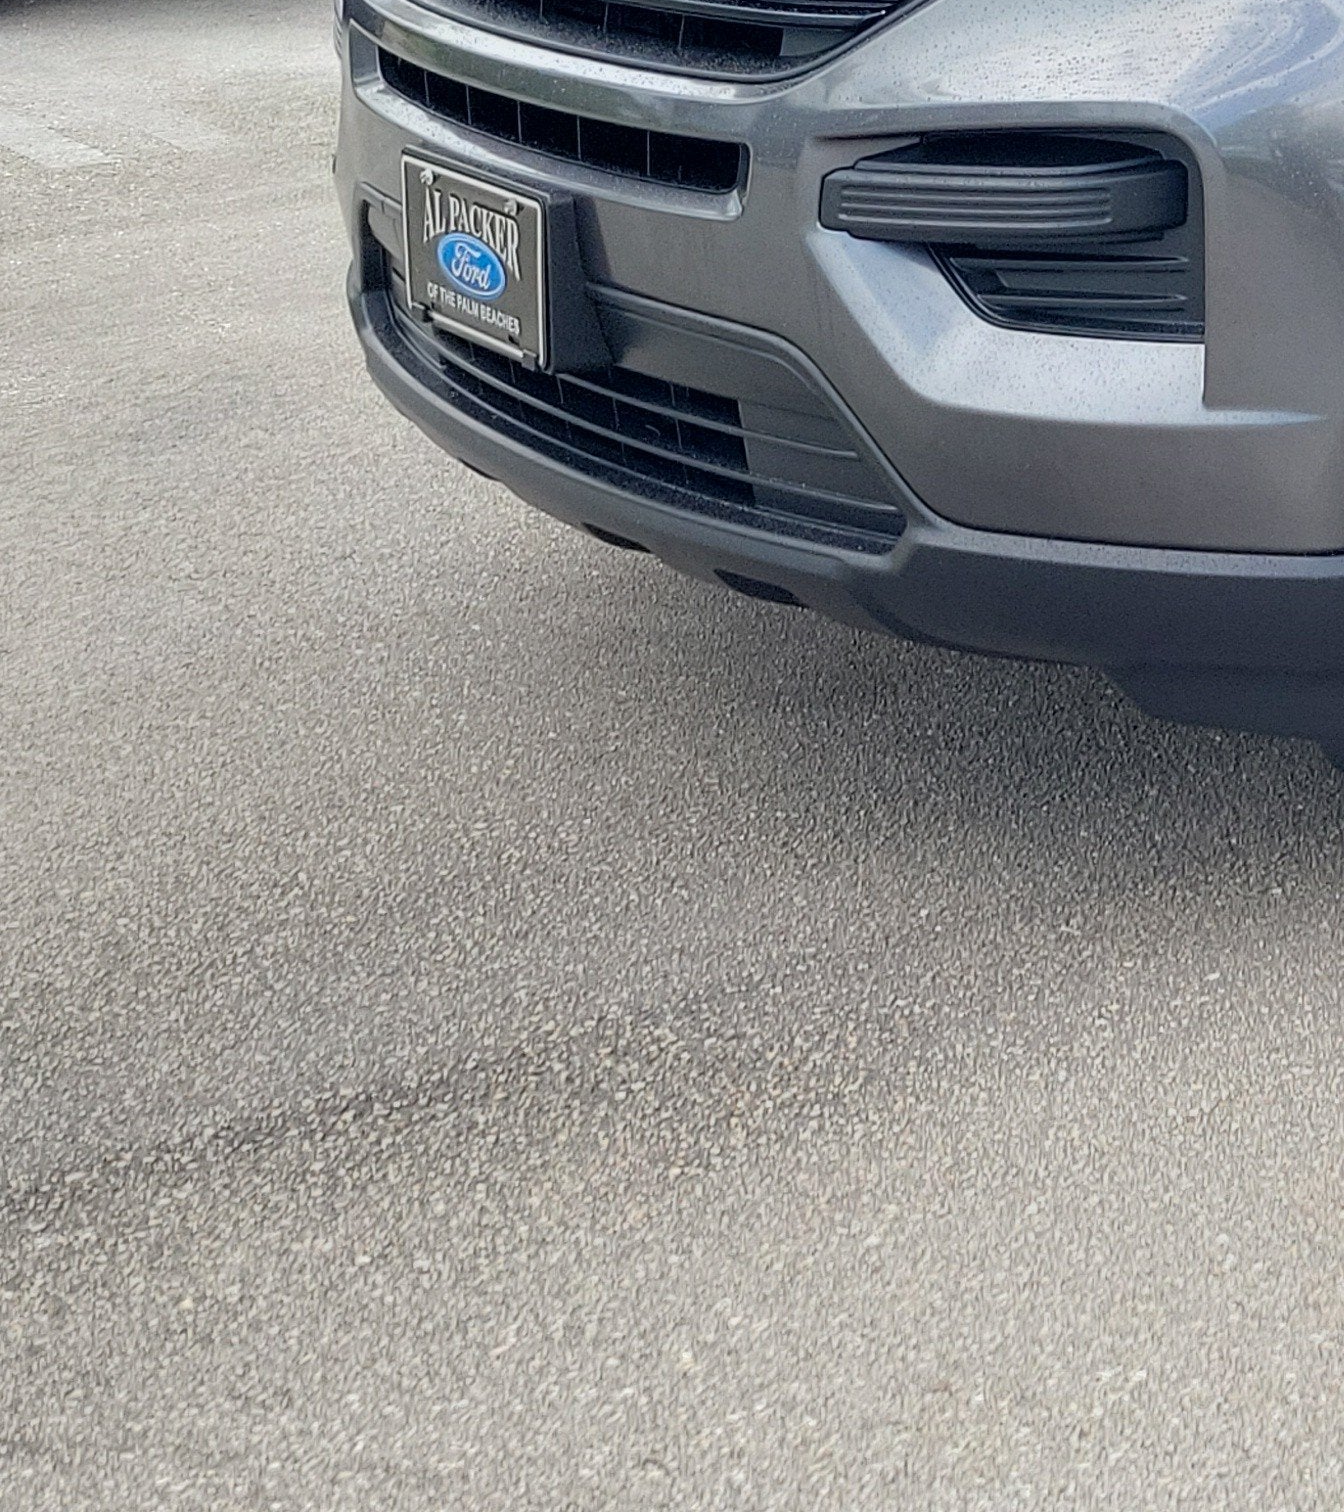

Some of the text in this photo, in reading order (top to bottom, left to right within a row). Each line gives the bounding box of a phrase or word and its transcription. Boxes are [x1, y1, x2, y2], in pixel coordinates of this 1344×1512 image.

[423, 185, 521, 282] AL PACKER
[451, 242, 491, 290] Ford
[426, 281, 520, 336] OF THE PALM BEACHES
